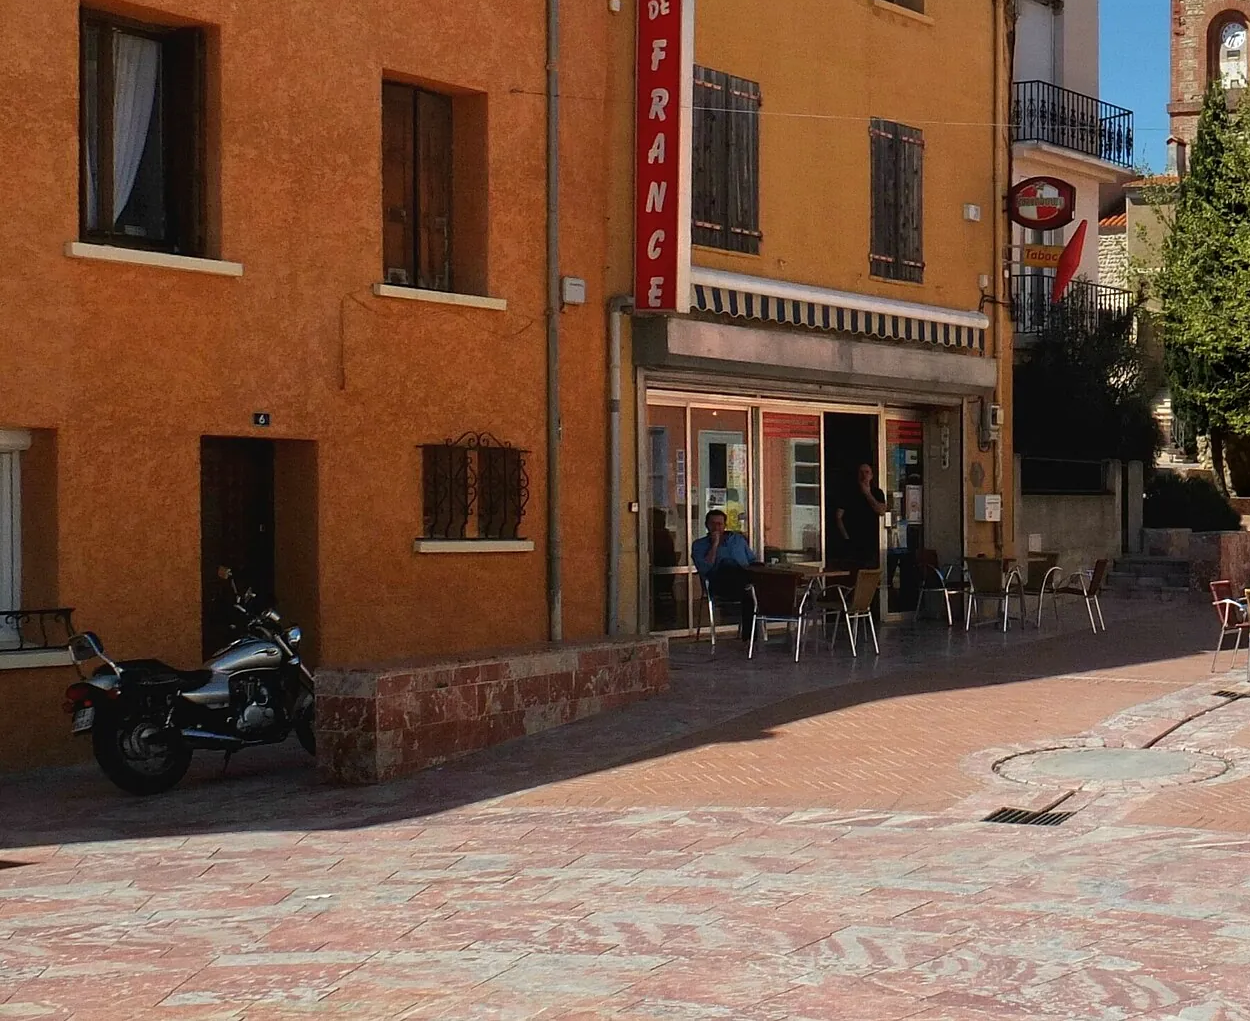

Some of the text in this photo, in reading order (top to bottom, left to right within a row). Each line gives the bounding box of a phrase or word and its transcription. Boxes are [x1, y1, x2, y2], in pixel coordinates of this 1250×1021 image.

[646, 39, 670, 308] FRANCE
[1025, 248, 1059, 261] Tabac
[258, 414, 266, 424] 6
